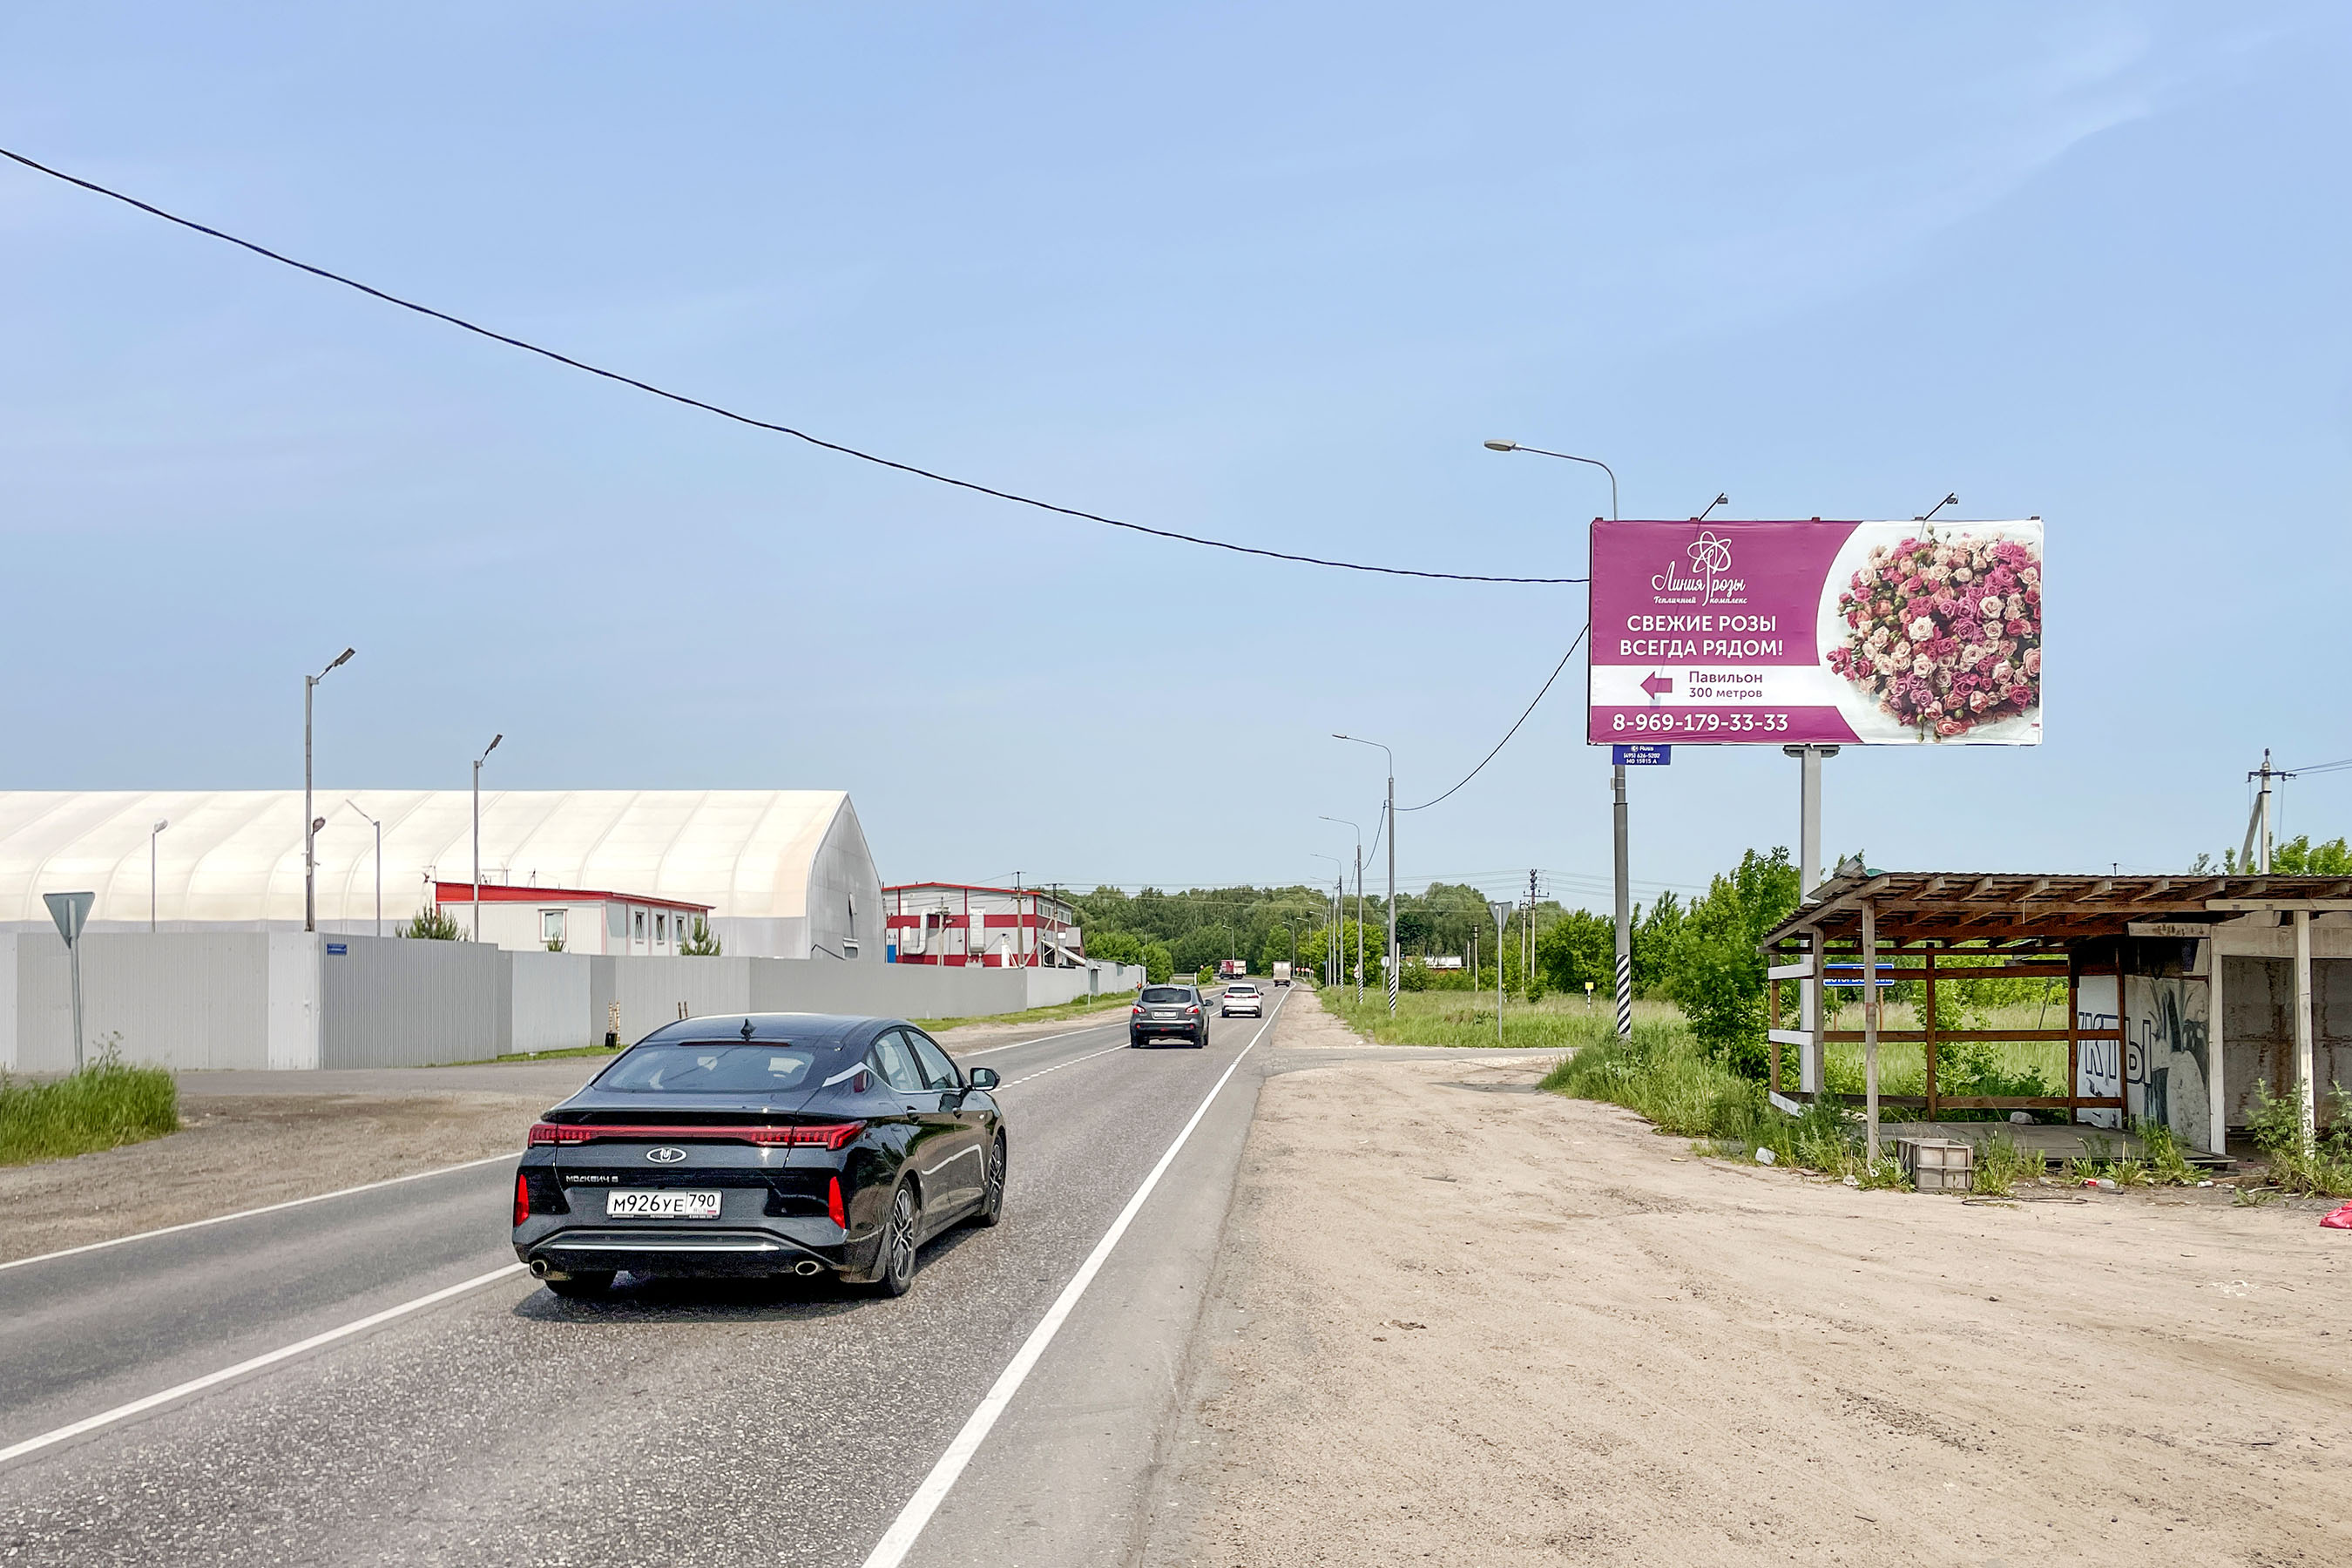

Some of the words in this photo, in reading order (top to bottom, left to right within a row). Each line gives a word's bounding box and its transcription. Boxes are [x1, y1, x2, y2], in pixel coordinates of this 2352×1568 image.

[1652, 561, 1706, 591] Линия
[1710, 578, 1746, 598] розы
[1626, 615, 1713, 632] СВЕЖИЕ
[1719, 615, 1776, 632] РОЗЫ
[1619, 639, 1698, 659] ВСЕГДА
[1703, 639, 1784, 659] РЯДОМ!
[1689, 671, 1763, 684] Павильон
[1689, 687, 1713, 698] 300
[1716, 689, 1762, 700] метров
[1612, 713, 1788, 732] 8-969-179-33-33
[613, 1194, 684, 1213] М926УЕ
[689, 1194, 715, 1207] 790
